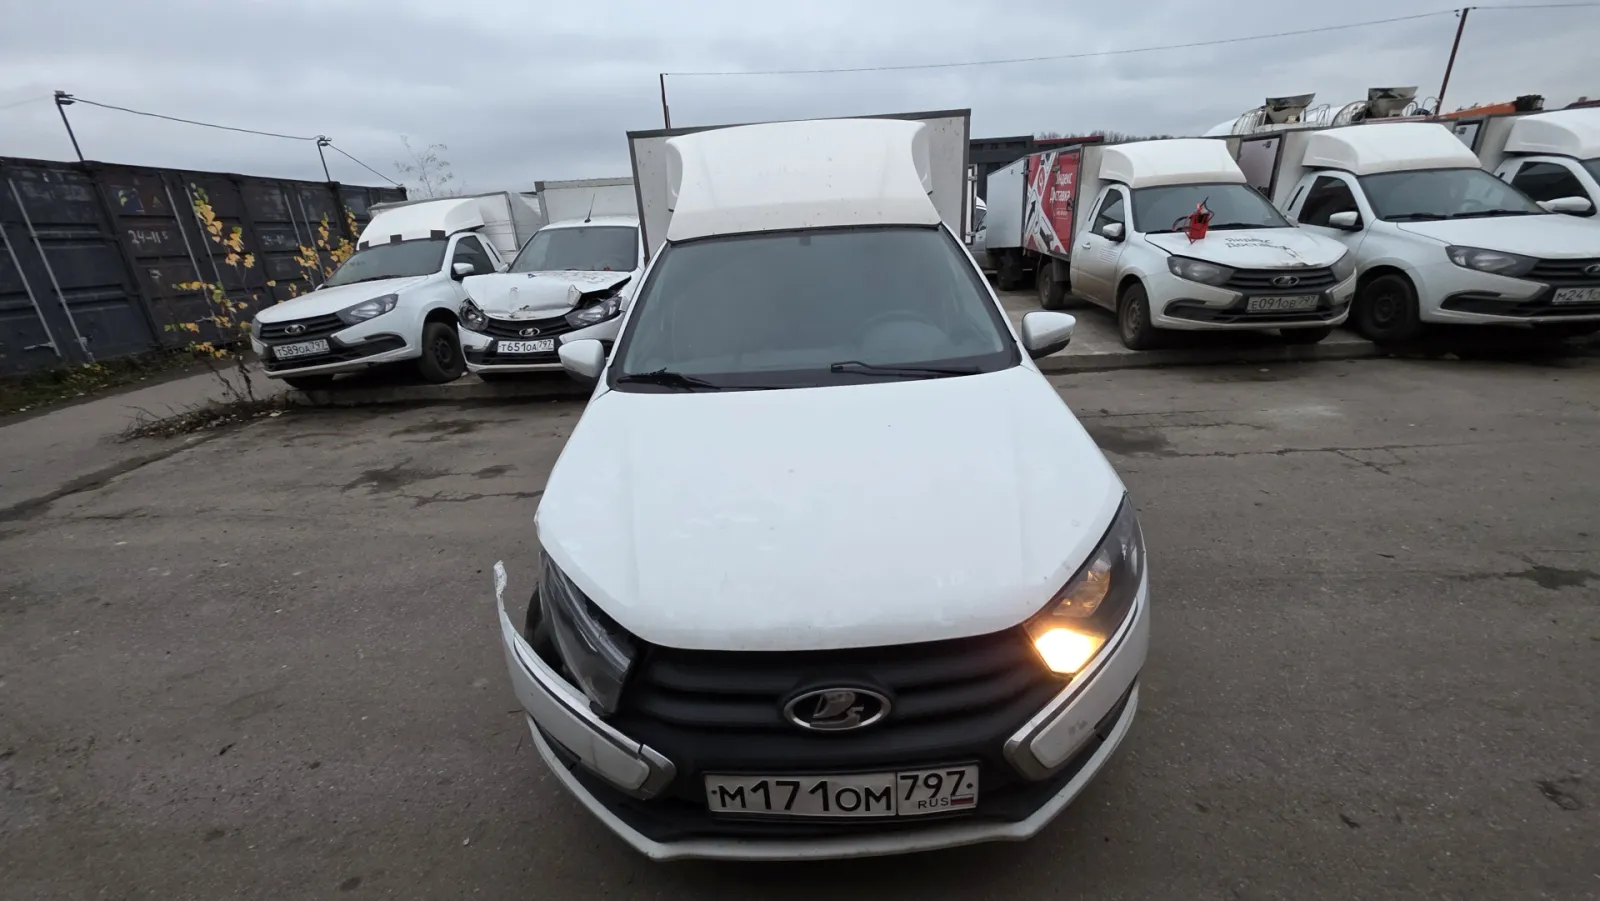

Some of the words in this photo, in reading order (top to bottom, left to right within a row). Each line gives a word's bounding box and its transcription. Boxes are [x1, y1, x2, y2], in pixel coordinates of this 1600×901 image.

[718, 780, 892, 812] М171ОМ
[899, 770, 966, 801] 797
[917, 796, 950, 810] RUS
